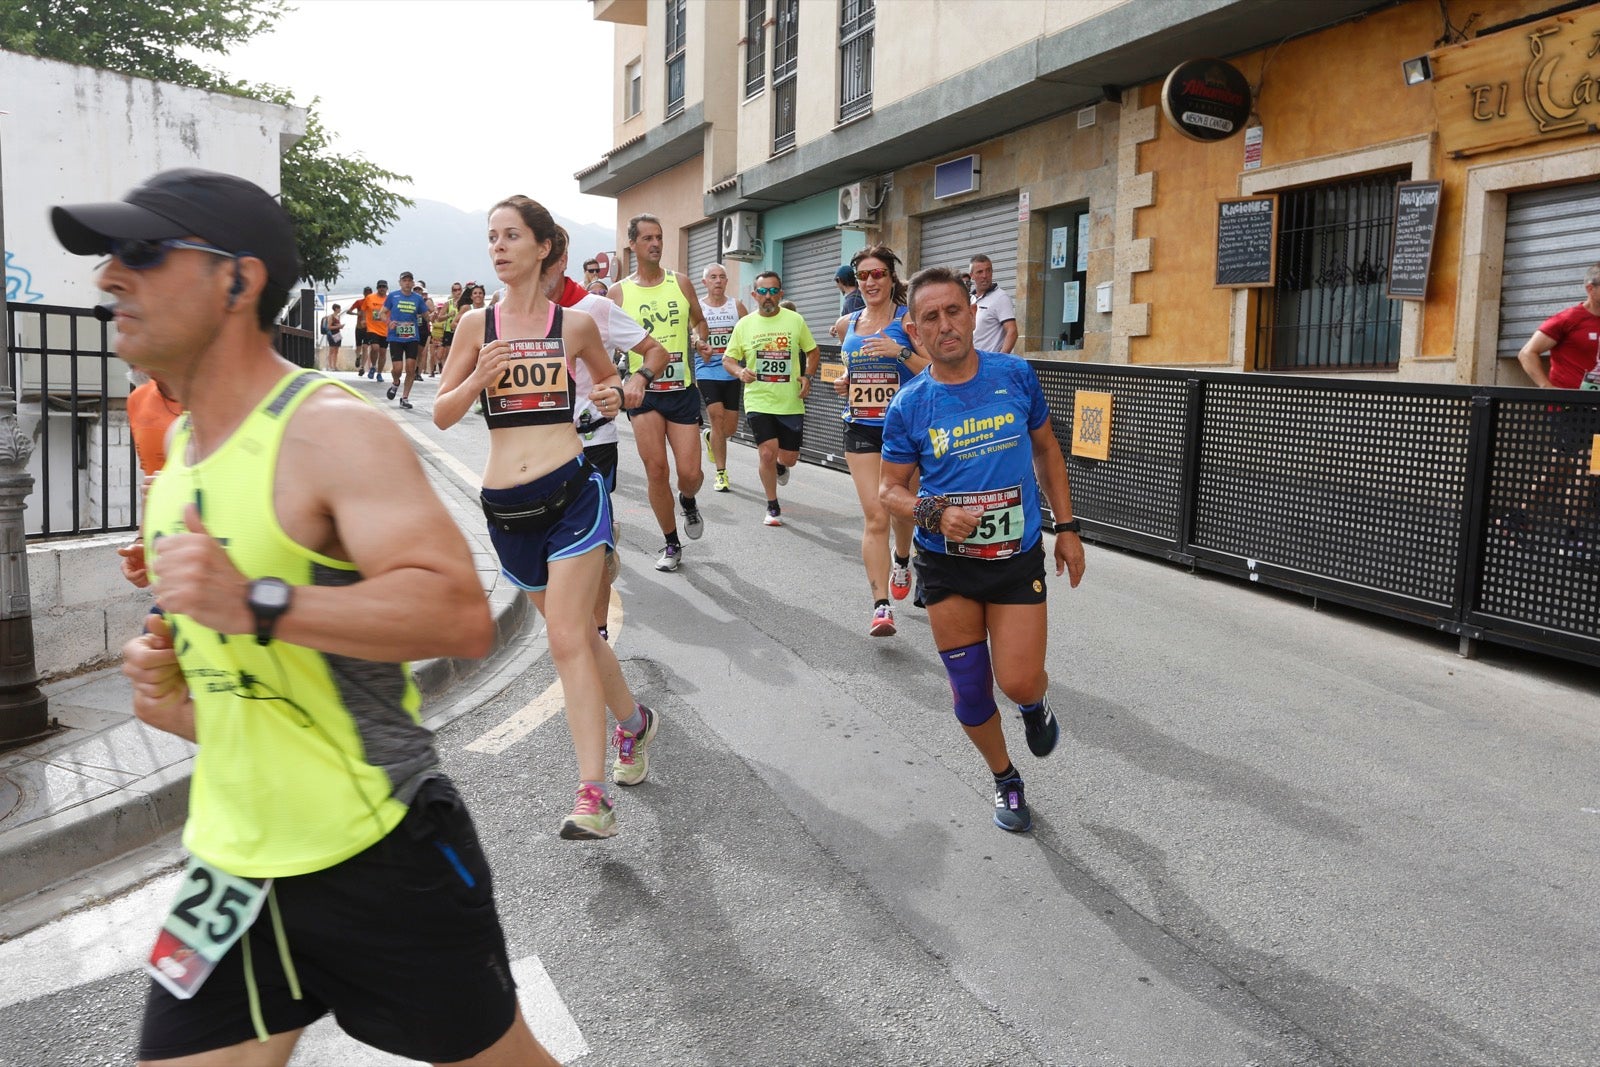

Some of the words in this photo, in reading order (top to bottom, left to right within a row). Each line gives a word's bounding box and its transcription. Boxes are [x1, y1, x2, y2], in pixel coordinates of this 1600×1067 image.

[1472, 84, 1509, 121] El
[498, 362, 562, 389] 2007
[762, 360, 786, 373] 289
[854, 387, 896, 403] 2109
[952, 412, 1015, 438] olimpo
[953, 432, 994, 448] deportes
[958, 451, 979, 461] TRAIL
[987, 440, 1018, 454] RUNNING
[963, 495, 977, 504] GRAN
[978, 493, 997, 504] PREMIO
[997, 492, 1003, 501] DE
[173, 867, 251, 944] 25
